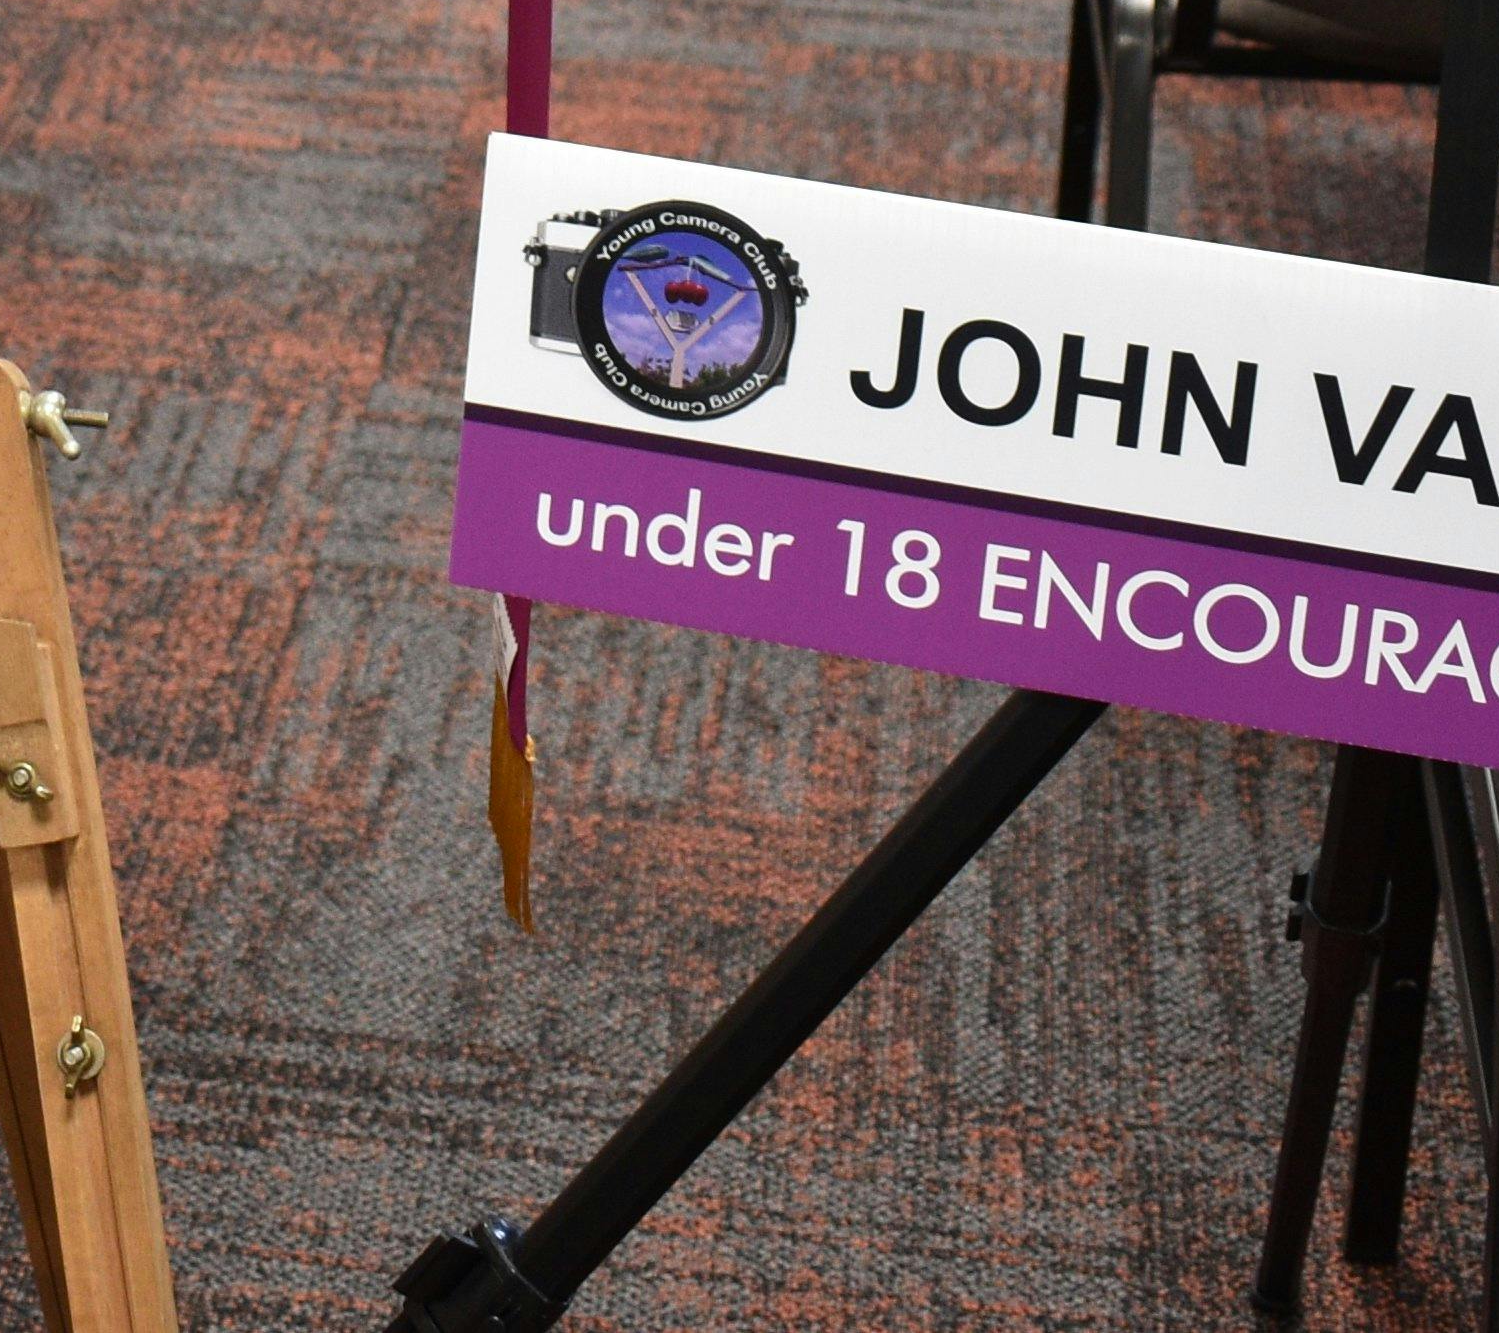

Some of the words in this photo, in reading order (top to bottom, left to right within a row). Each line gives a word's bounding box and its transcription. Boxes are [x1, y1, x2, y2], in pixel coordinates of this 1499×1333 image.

[596, 217, 656, 263] Young
[658, 211, 743, 244] Camera
[742, 237, 779, 291] Club
[594, 342, 629, 387] Club
[708, 370, 769, 407] Young
[848, 306, 1259, 467] JOHN
[630, 384, 707, 416] Camera
[536, 487, 795, 583] under
[837, 518, 942, 610] 18
